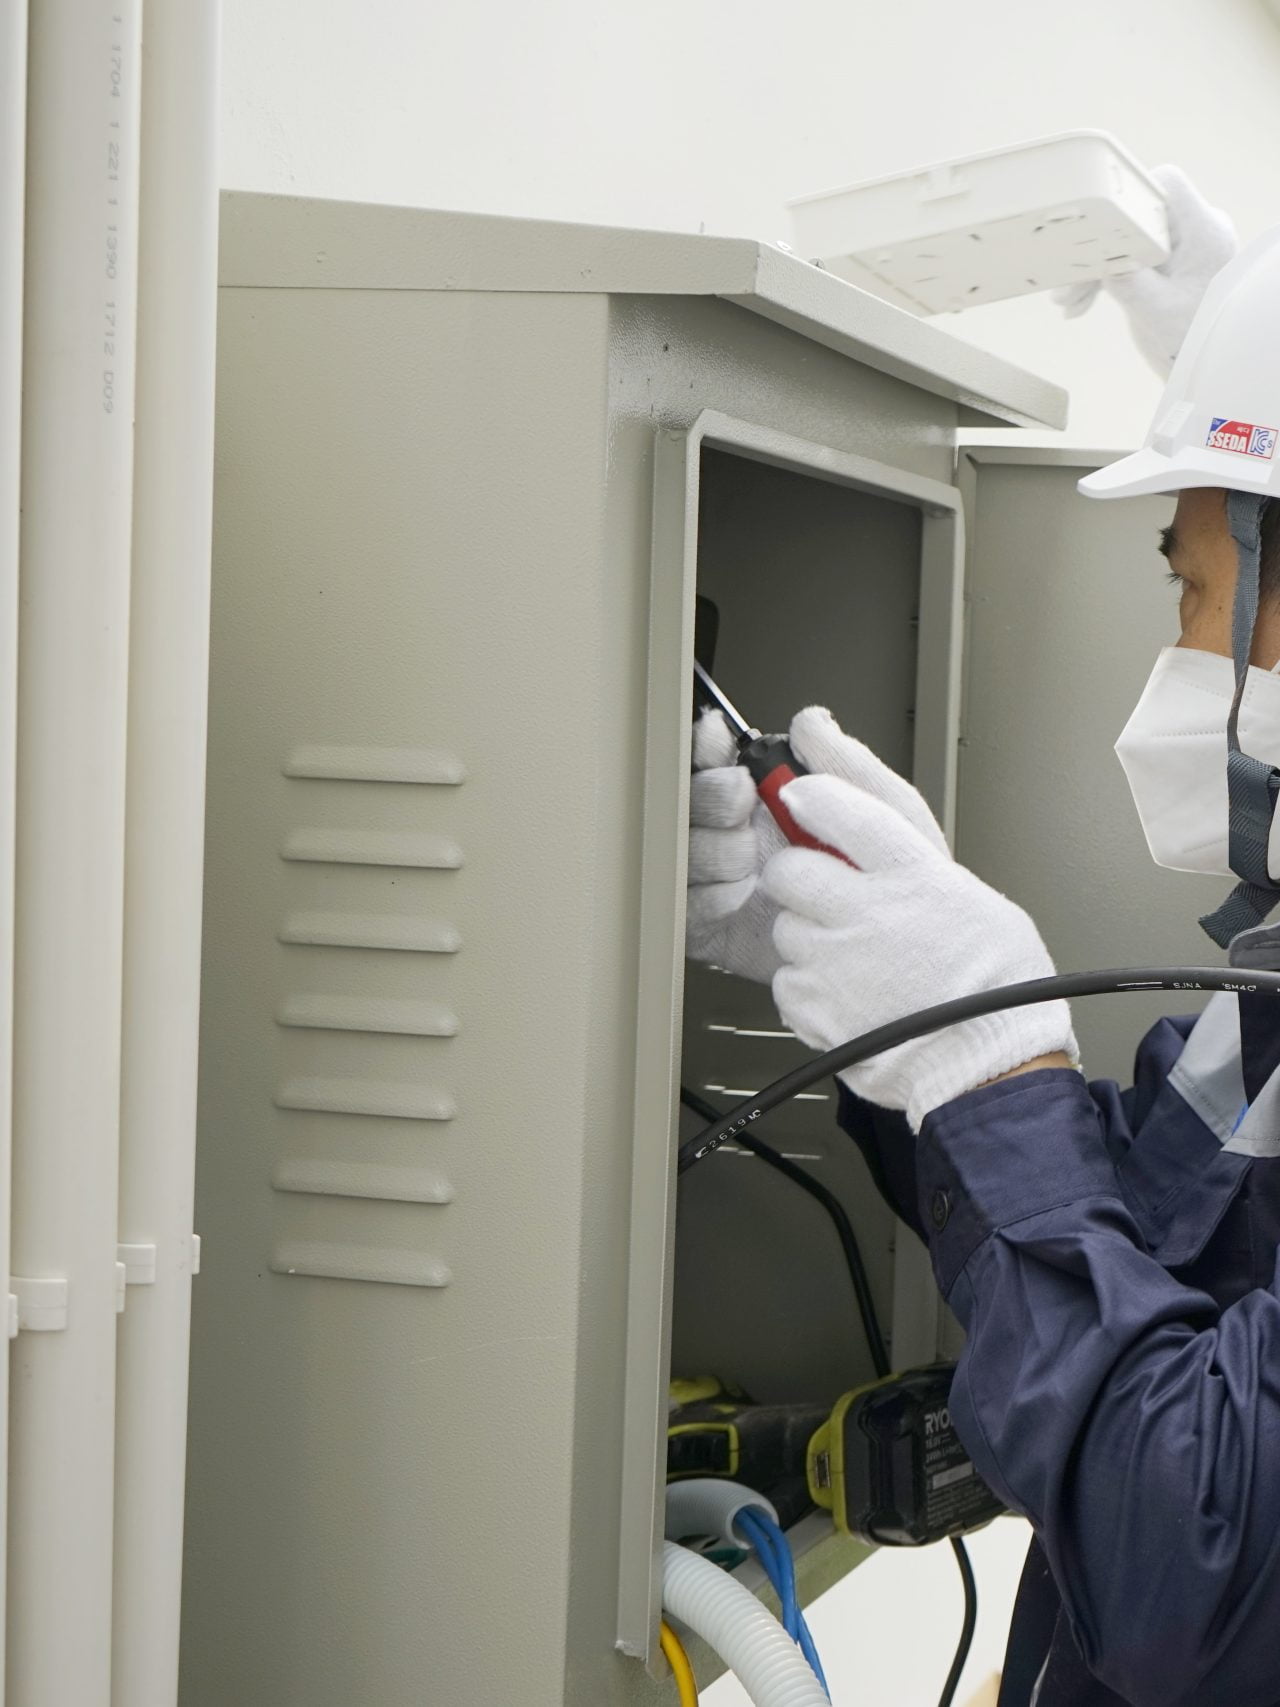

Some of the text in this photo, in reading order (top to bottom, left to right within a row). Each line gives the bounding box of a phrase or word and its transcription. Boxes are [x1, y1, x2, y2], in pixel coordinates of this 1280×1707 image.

[110, 44, 121, 98] 1704
[108, 141, 119, 181] 221
[105, 224, 117, 280] 1390
[104, 301, 116, 358] 1712
[1208, 431, 1248, 452] SSEDA
[924, 1407, 954, 1436] RYO
